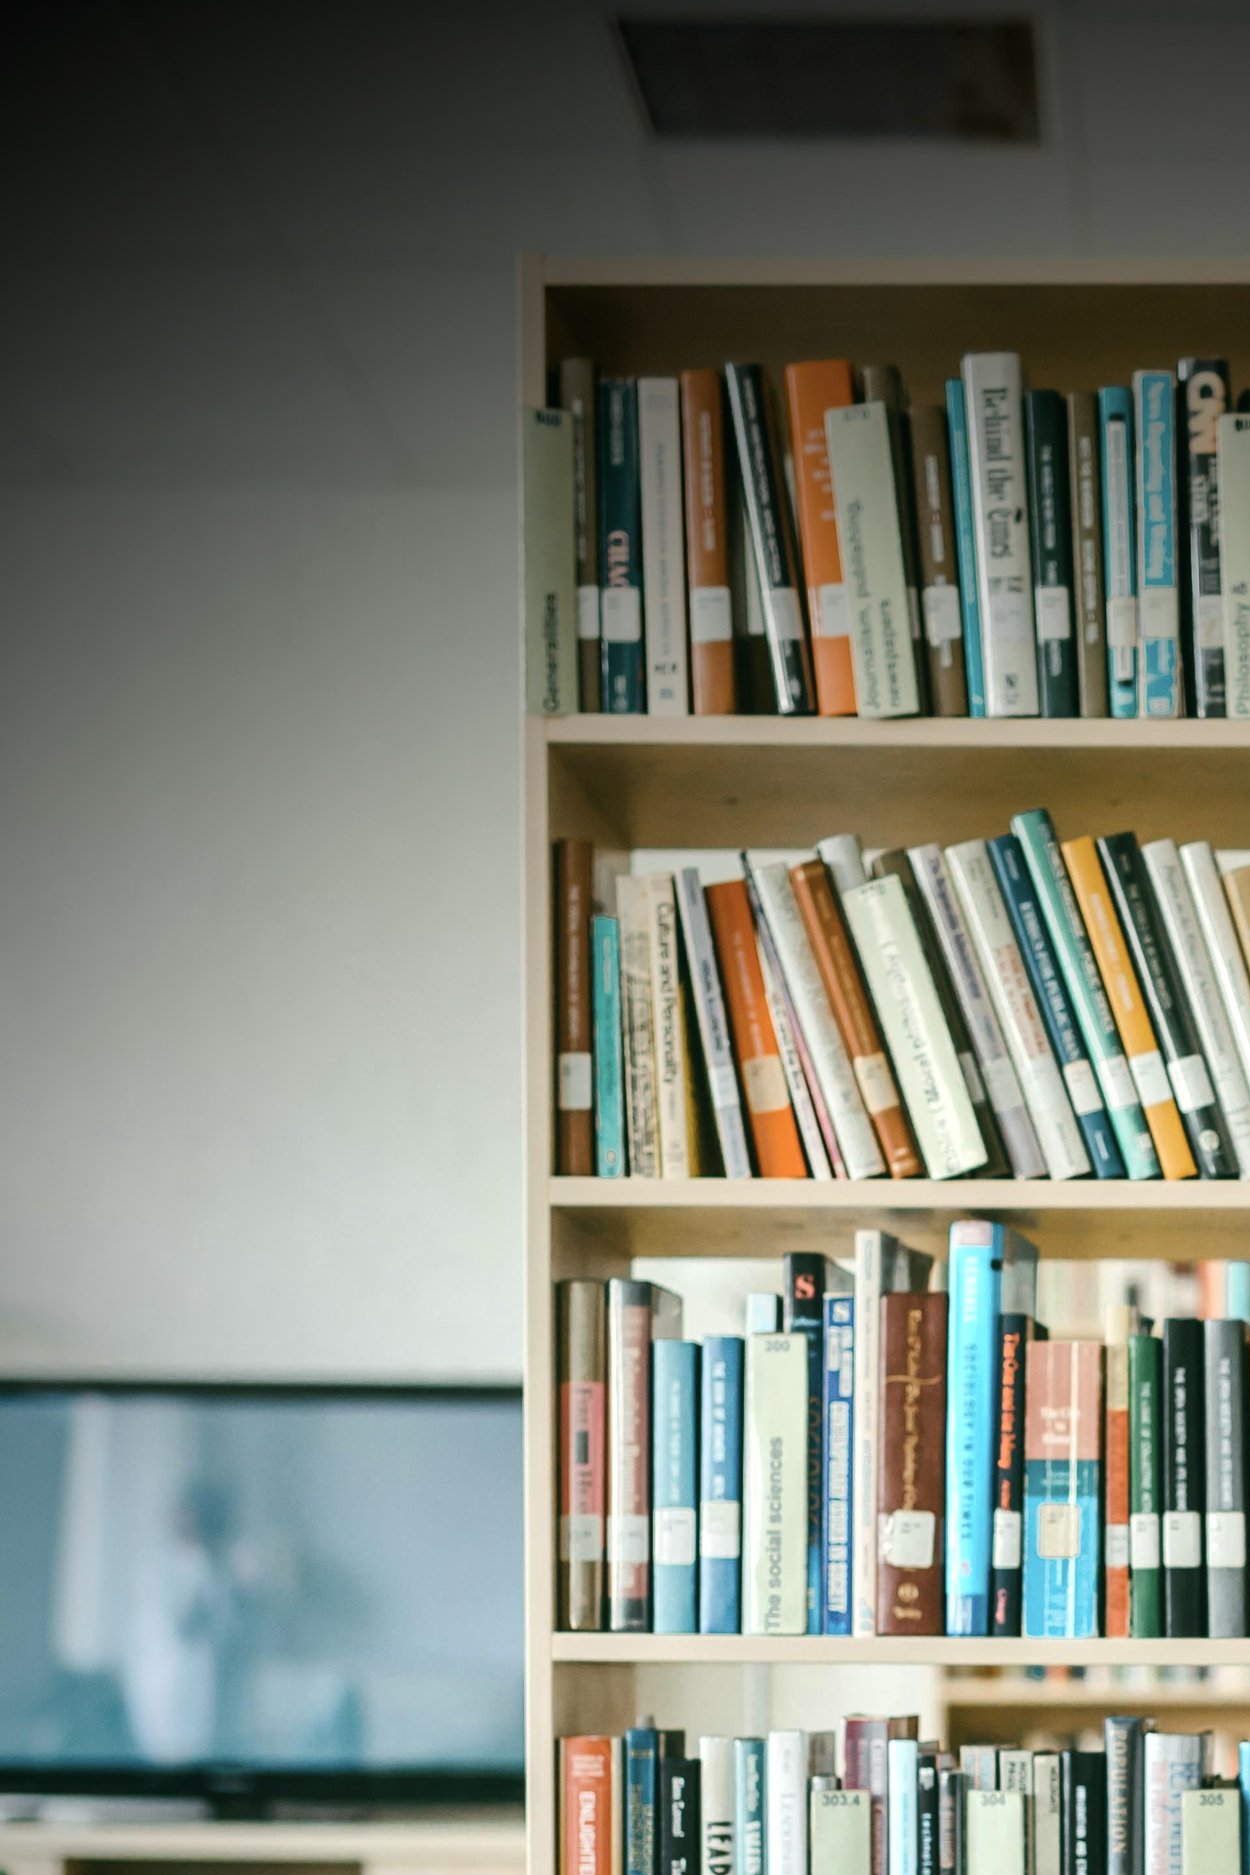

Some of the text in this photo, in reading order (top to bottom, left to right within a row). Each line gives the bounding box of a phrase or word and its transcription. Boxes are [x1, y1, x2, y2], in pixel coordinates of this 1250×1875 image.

[544, 592, 560, 712] Generalities
[1230, 602, 1250, 714] Philosophy
[658, 902, 679, 1084] Culture and Personality
[964, 1343, 978, 1428] SOCIOLOGY
[765, 1437, 783, 1631] The social sciences
[1111, 1729, 1127, 1854] POPULATION
[1199, 1794, 1225, 1807] 305
